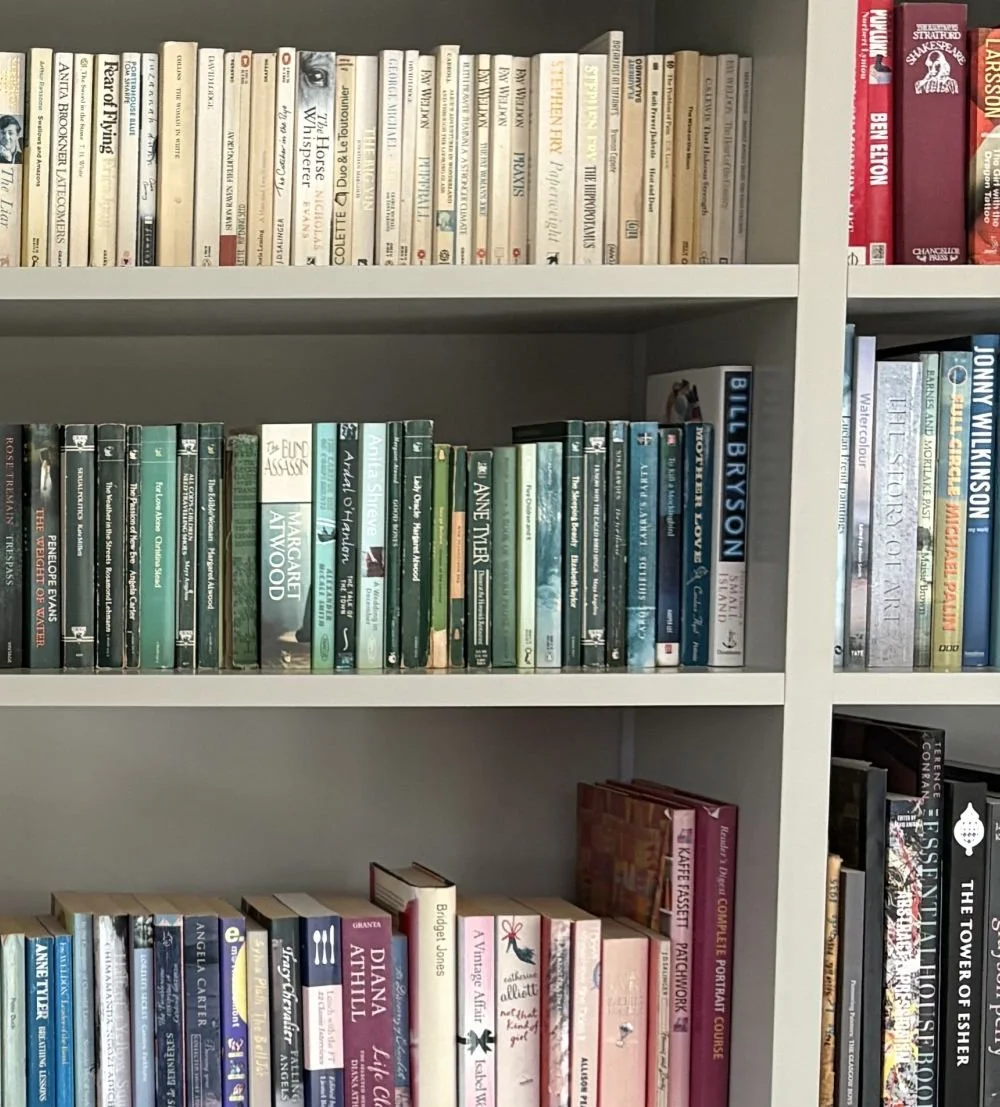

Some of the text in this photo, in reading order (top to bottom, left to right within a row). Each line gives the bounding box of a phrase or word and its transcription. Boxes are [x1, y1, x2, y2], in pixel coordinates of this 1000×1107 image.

[100, 61, 118, 154] Fear of Flying
[985, 39, 1000, 118] LARSSON
[299, 107, 316, 188] Whisperer
[316, 114, 329, 181] The Horse
[870, 113, 887, 185] BEN ELTON
[724, 377, 748, 557] BILL BRYSON
[969, 346, 994, 519] JONNY WILKINSON
[342, 451, 354, 564] Ardal O'Hanlon
[474, 483, 490, 564] ANNE TYLER
[35, 508, 45, 647] THE WEIGHT OF WATER
[48, 535, 57, 622] PENELOPE EVANS
[269, 511, 284, 601] ATWOOD
[288, 512, 301, 601] MARGARET
[943, 502, 960, 631] MICHAEL PALIN
[434, 904, 447, 976] Bridget Jones
[472, 942, 485, 987] Vintage
[474, 930, 485, 939] A
[675, 847, 690, 1013] KAFFE FASSETT PATCHWORK
[713, 825, 729, 1059] Reader's Digest COMPLETE PORTRAIT COURSE
[36, 944, 48, 1019] ANNE TYLER
[197, 923, 207, 1027] ANGELA CARTER
[350, 944, 366, 1022] ATHILL
[371, 948, 387, 1016] DIANA
[474, 991, 486, 1023] Affair
[956, 880, 974, 1066] THE TOWER OF ESHER
[475, 1059, 486, 1091] Isabel
